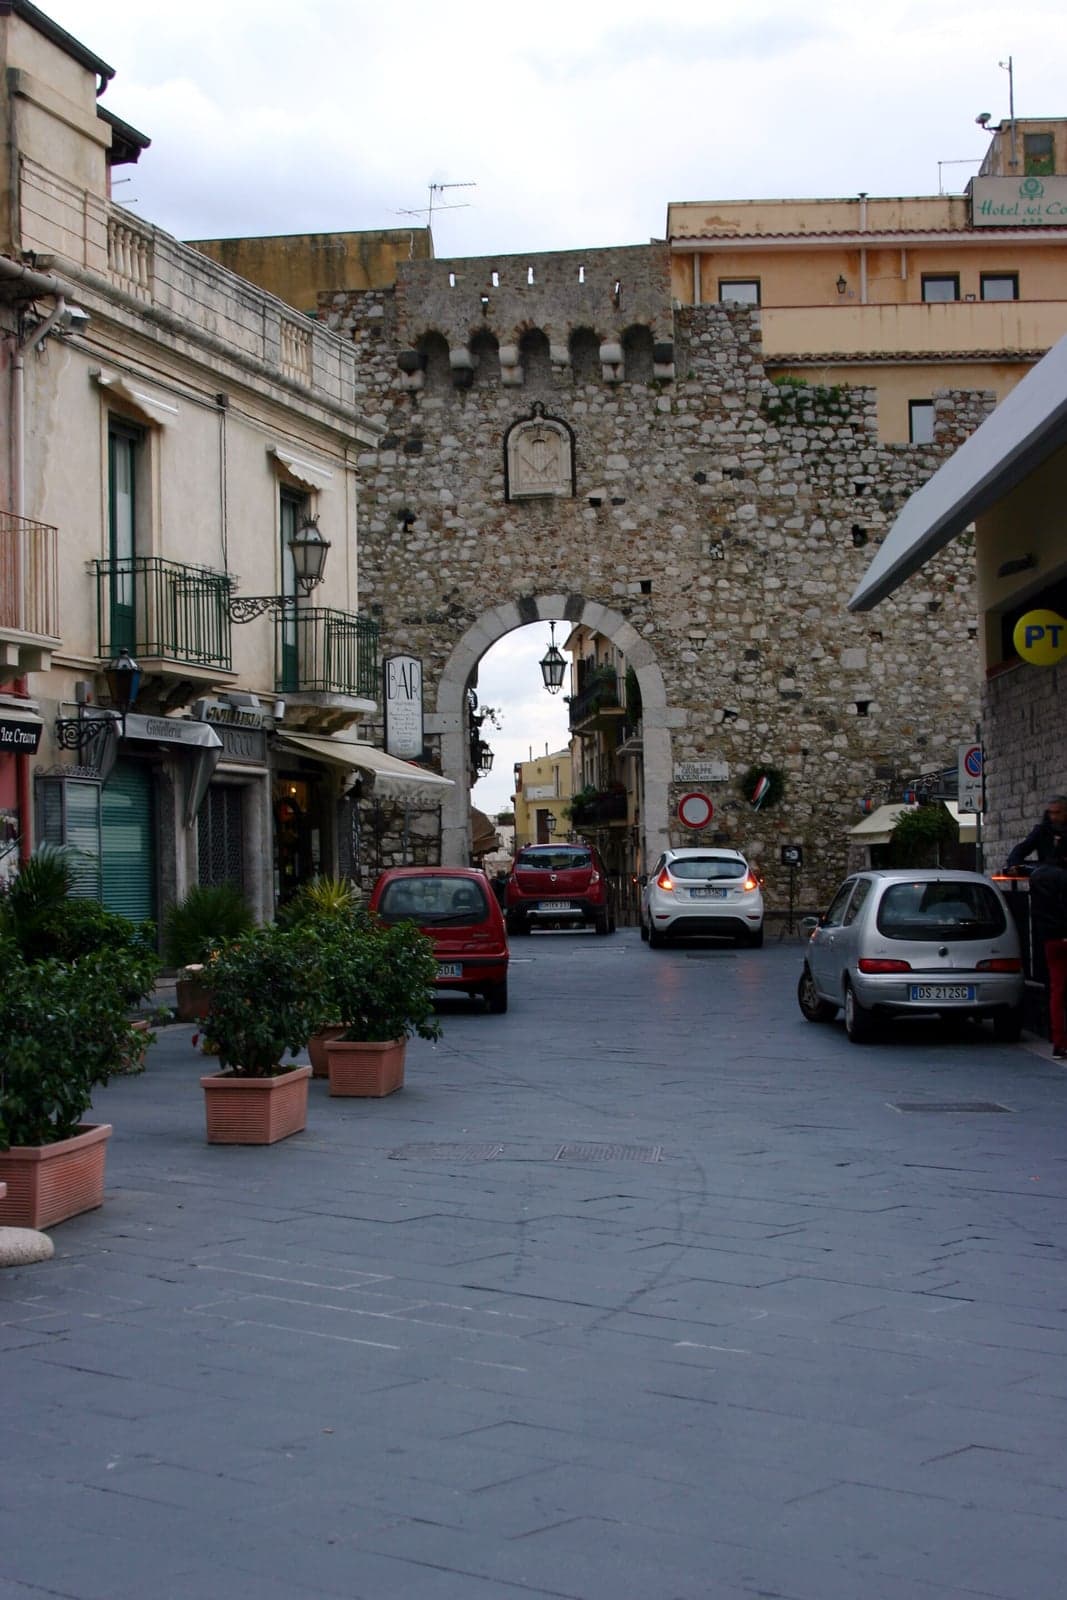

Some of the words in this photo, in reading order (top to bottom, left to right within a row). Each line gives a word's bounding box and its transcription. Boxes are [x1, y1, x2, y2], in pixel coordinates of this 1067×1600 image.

[976, 199, 1018, 216] Hotel
[1025, 624, 1064, 648] PT
[387, 661, 420, 701] BAR
[1, 726, 13, 742] Ice
[14, 728, 36, 744] Cream
